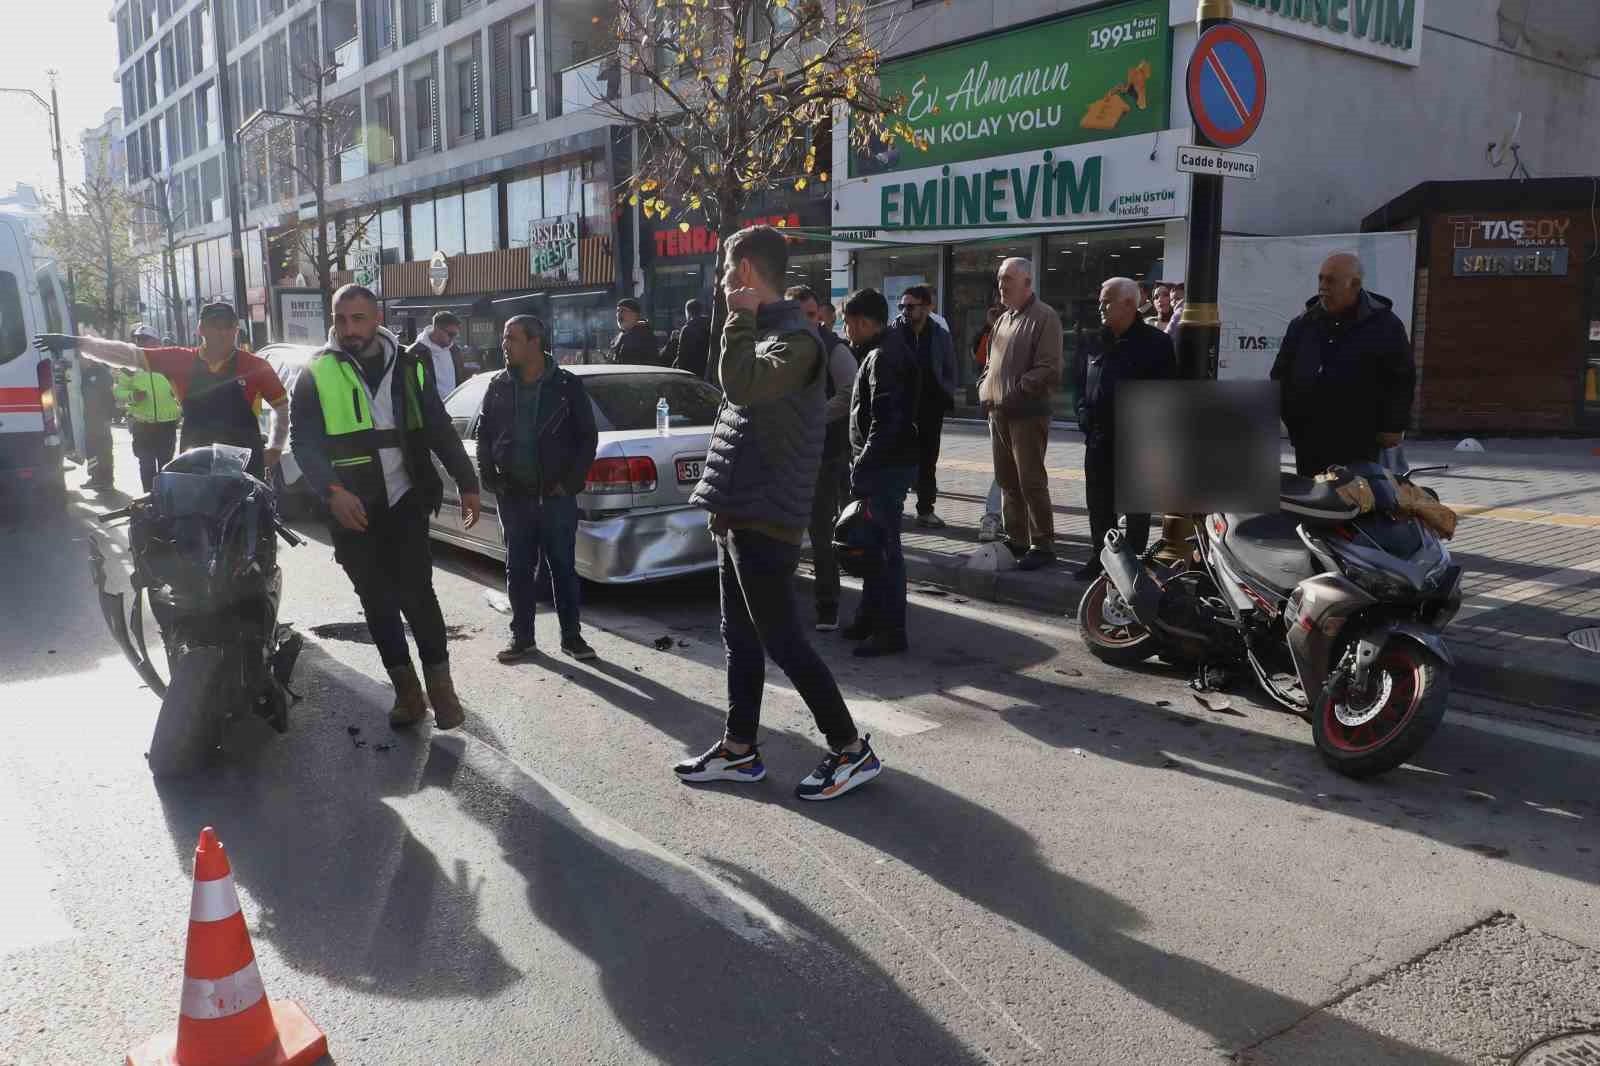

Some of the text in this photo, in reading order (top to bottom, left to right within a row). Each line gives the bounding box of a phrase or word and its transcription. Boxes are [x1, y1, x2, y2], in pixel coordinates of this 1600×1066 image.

[906, 79, 939, 122] Ev
[940, 115, 1002, 145] KOLAY
[1007, 105, 1062, 133] YOLU
[1181, 154, 1255, 173] Cadde Boyunca
[880, 150, 1103, 227] EMİNEVİM
[686, 463, 701, 478] 58
